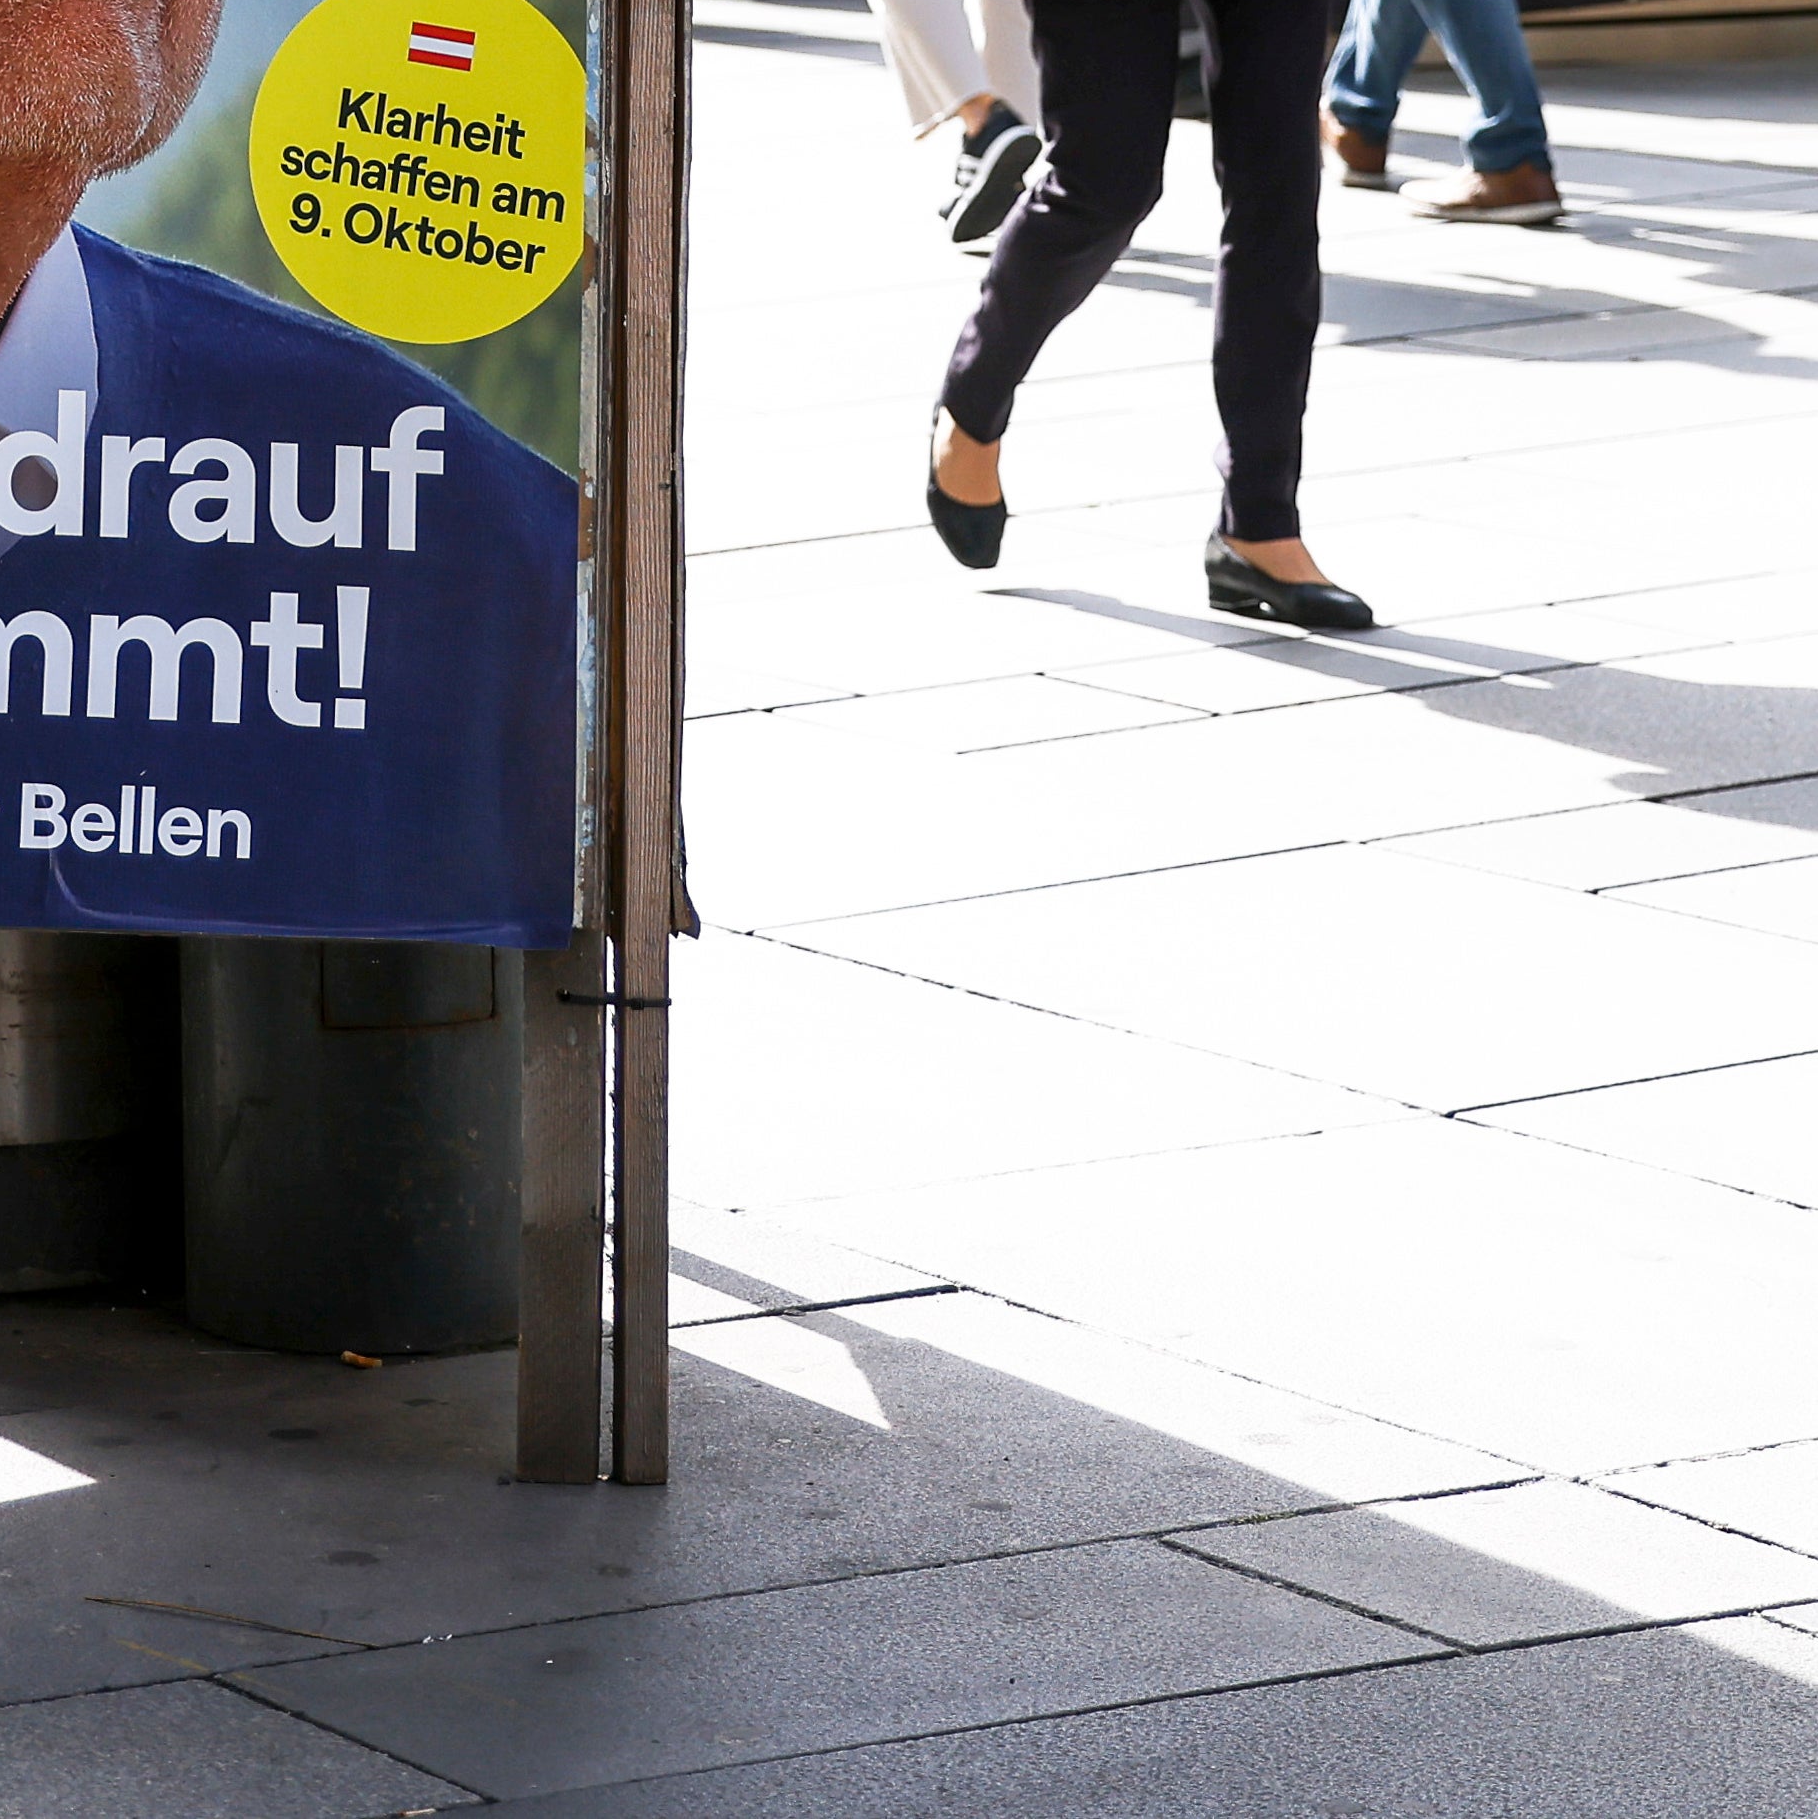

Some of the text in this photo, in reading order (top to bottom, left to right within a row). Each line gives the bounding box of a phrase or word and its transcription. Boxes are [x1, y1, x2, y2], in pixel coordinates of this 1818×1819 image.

[337, 87, 526, 159] Klarheit
[280, 142, 565, 223] schaffen am
[288, 192, 546, 275] 9. Oktober
[18, 783, 252, 861] Bellen
